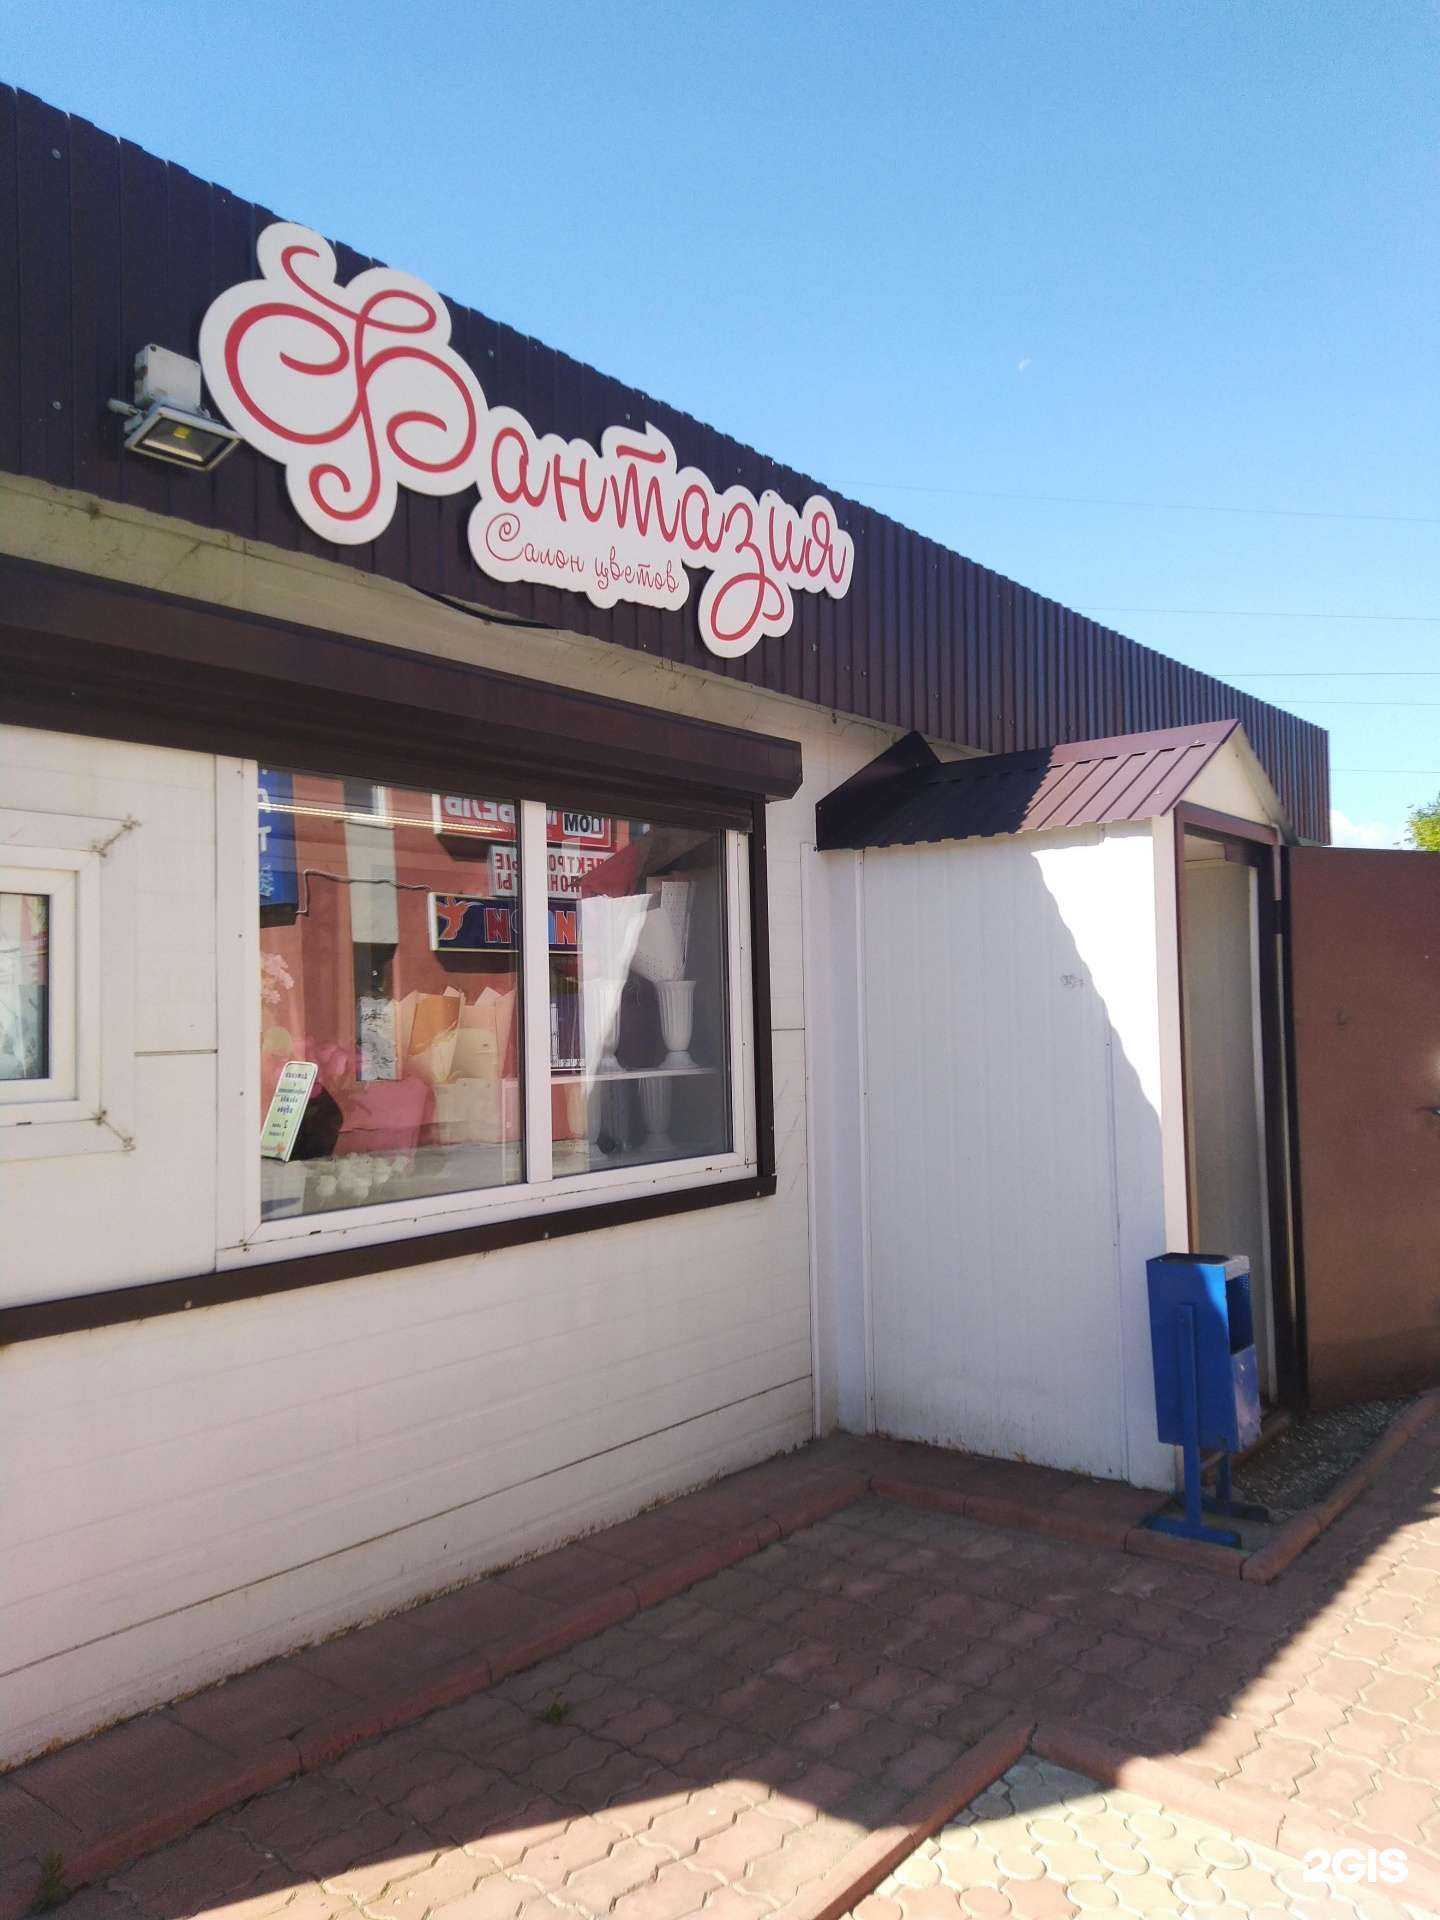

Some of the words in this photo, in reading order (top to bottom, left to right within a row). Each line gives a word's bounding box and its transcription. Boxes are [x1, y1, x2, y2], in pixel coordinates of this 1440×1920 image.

[224, 244, 847, 642] Фантазия
[485, 512, 585, 573] Салон
[594, 545, 680, 593] цветов
